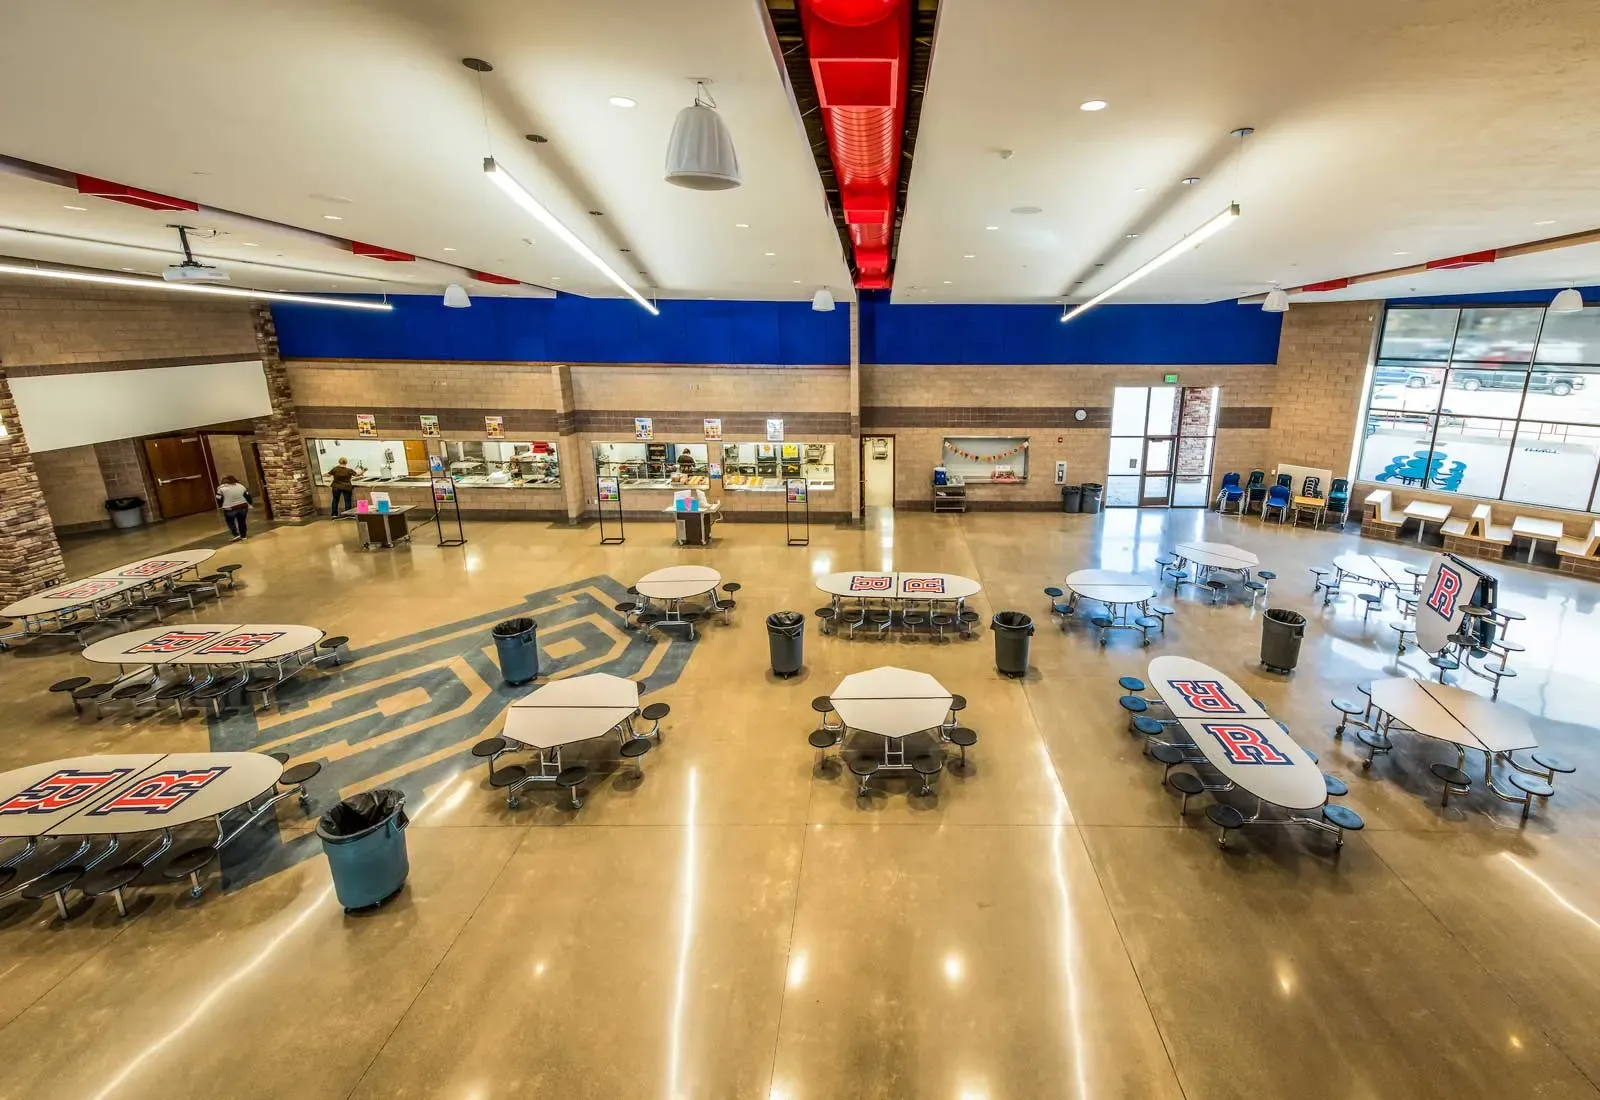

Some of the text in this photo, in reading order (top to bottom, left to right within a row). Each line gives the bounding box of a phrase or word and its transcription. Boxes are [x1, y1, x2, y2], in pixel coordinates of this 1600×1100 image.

[1426, 563, 1463, 621] R
[122, 631, 220, 655] R
[194, 632, 287, 655] R
[1167, 679, 1246, 714] R
[1201, 723, 1294, 766] R
[0, 768, 135, 815] R
[84, 767, 231, 816] R
